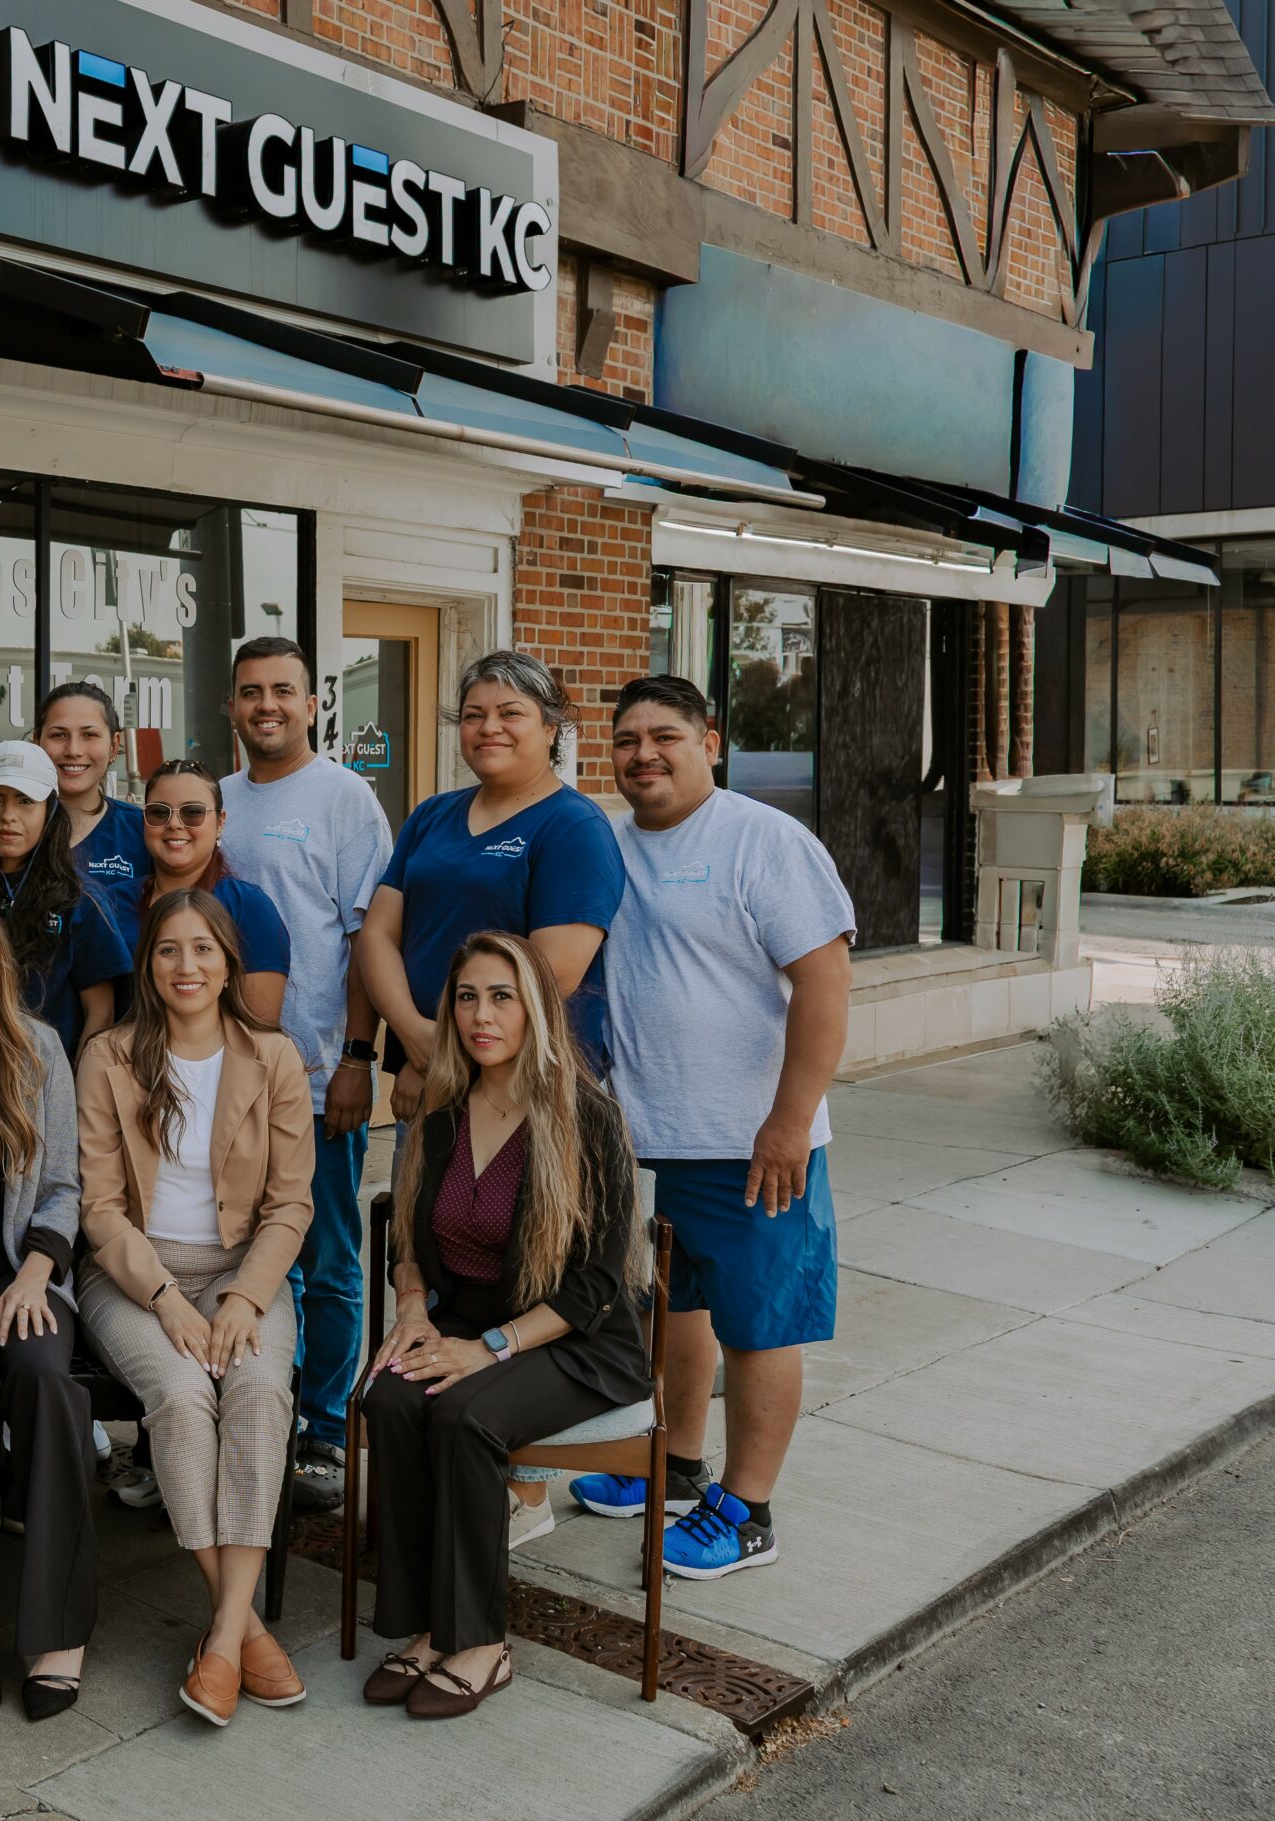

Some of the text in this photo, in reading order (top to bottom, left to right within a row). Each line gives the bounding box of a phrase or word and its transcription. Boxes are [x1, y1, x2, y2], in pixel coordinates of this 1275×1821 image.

[10, 25, 552, 291] NEXT GUEST KC
[59, 549, 197, 628] City's
[322, 675, 339, 763] 34
[357, 743, 386, 755] GUEST
[353, 761, 365, 771] KC
